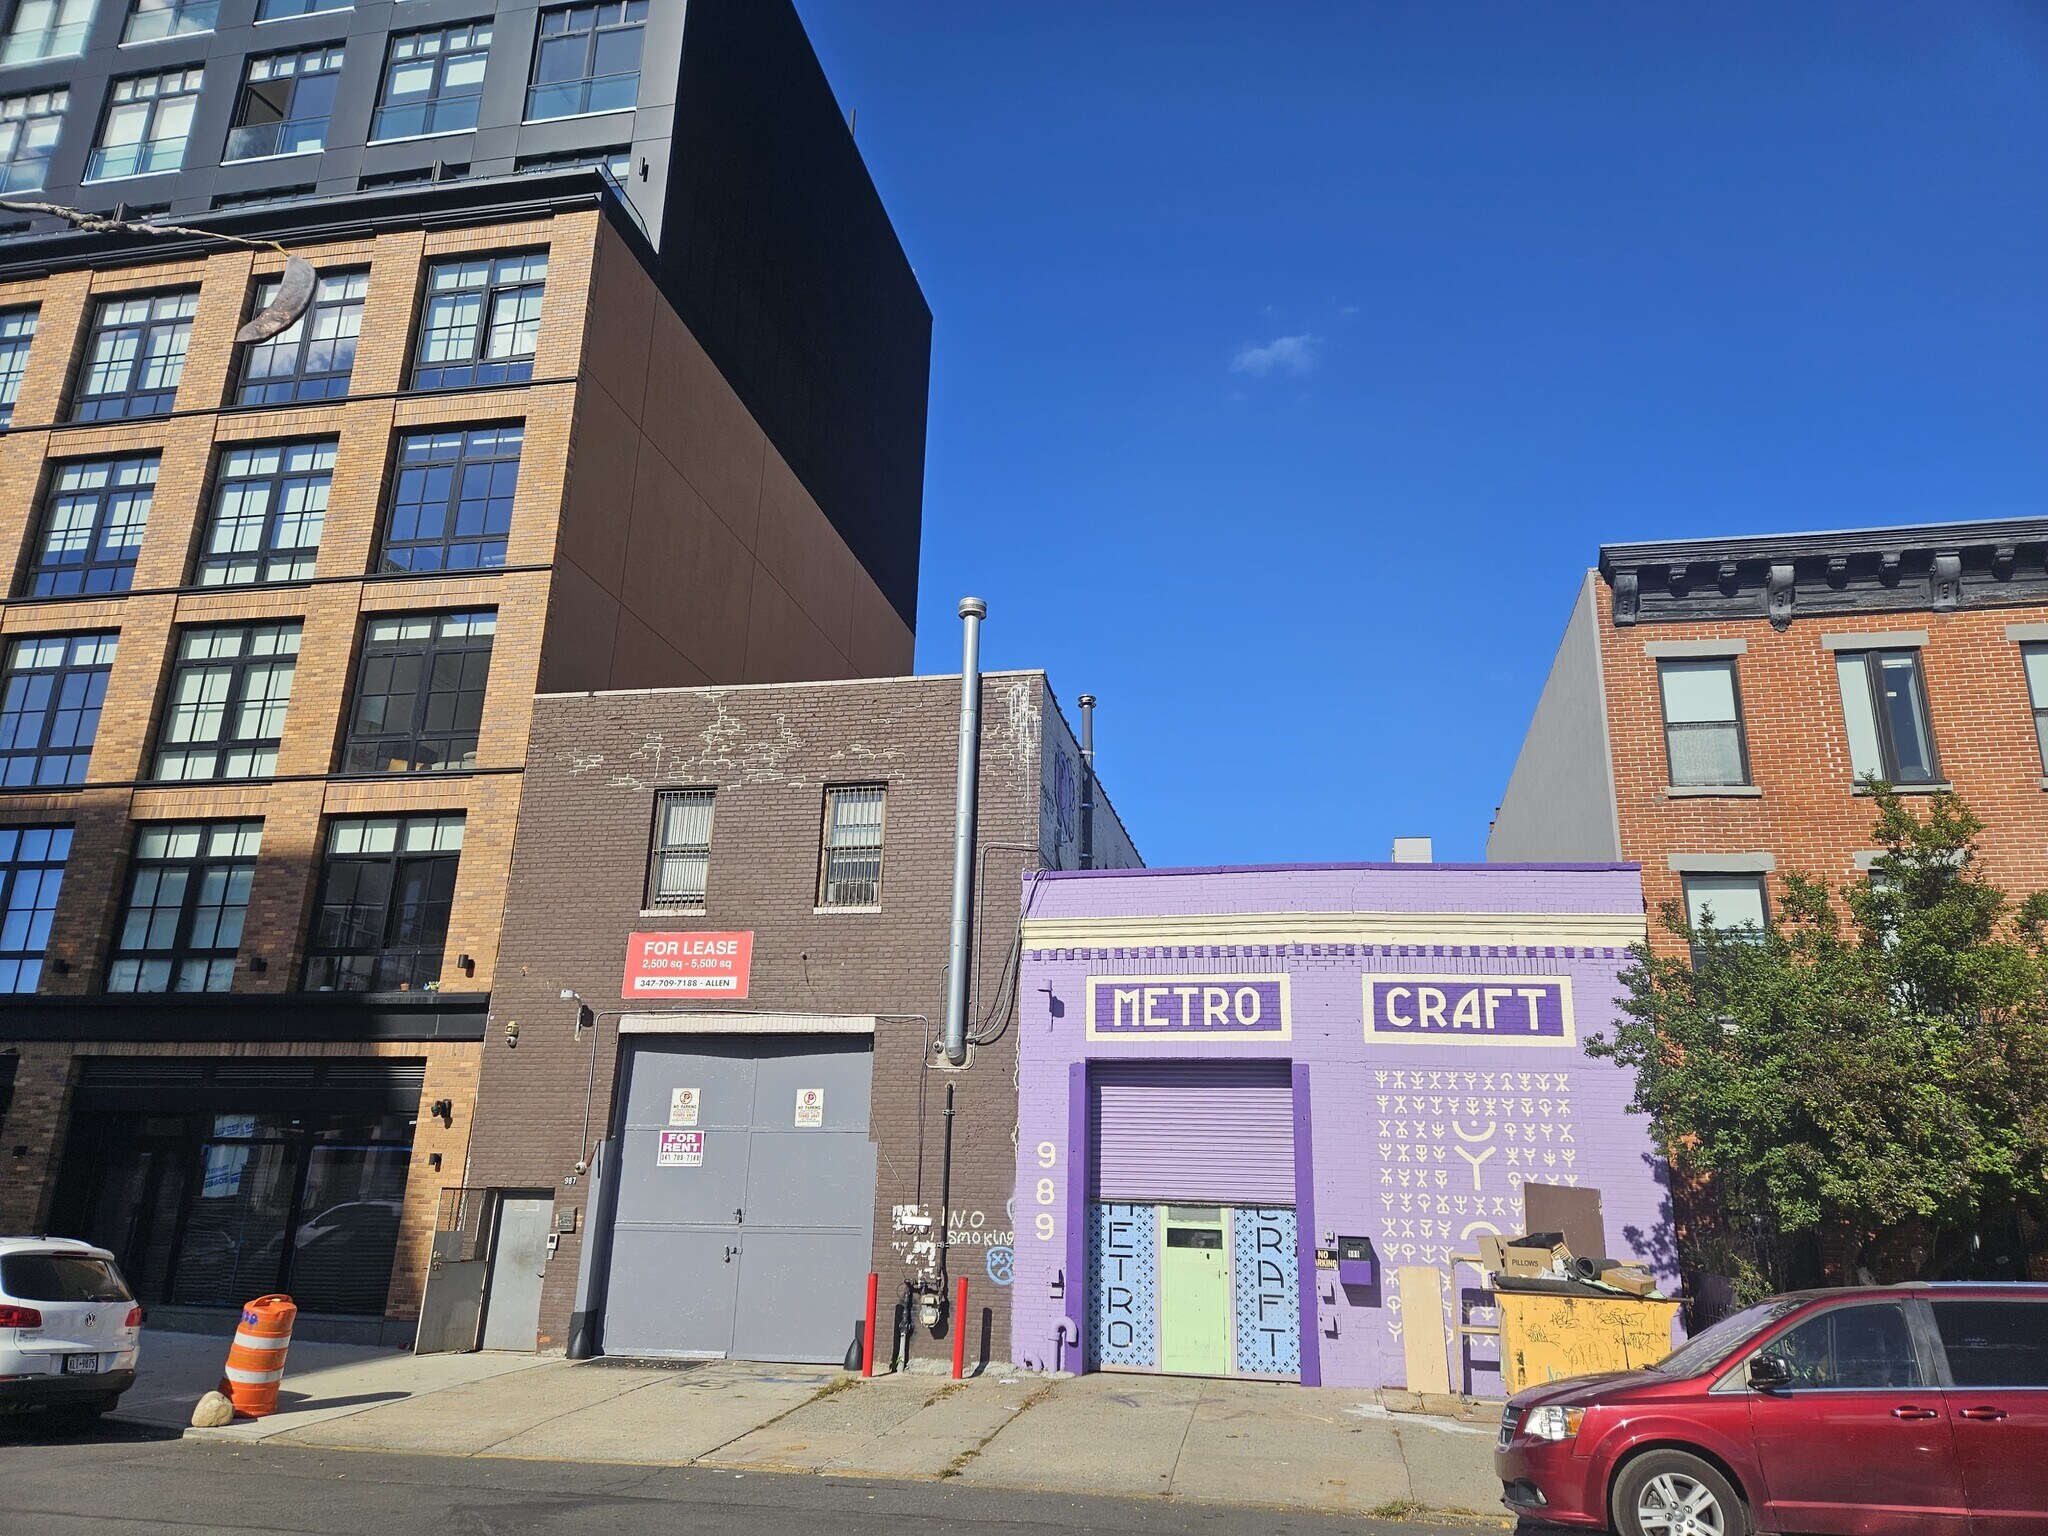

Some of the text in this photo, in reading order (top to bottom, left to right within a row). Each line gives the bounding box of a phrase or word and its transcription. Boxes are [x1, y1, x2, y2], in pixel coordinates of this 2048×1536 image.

[644, 941, 738, 955] FOR LEASE
[642, 959, 668, 970] 2,500
[670, 961, 683, 970] sq
[691, 959, 717, 970] 5,500
[719, 961, 732, 970] sq
[705, 979, 730, 987] ALLEN
[1114, 987, 1261, 1027] METRO
[1386, 987, 1547, 1031] CRAFT
[667, 1133, 696, 1143] FOR
[662, 1143, 700, 1152] RENT
[564, 1177, 577, 1185] 987
[1035, 1141, 1056, 1241] 989
[949, 1210, 985, 1228] NO
[1317, 1250, 1329, 1259] NO
[1511, 1259, 1539, 1267] PILLOWS
